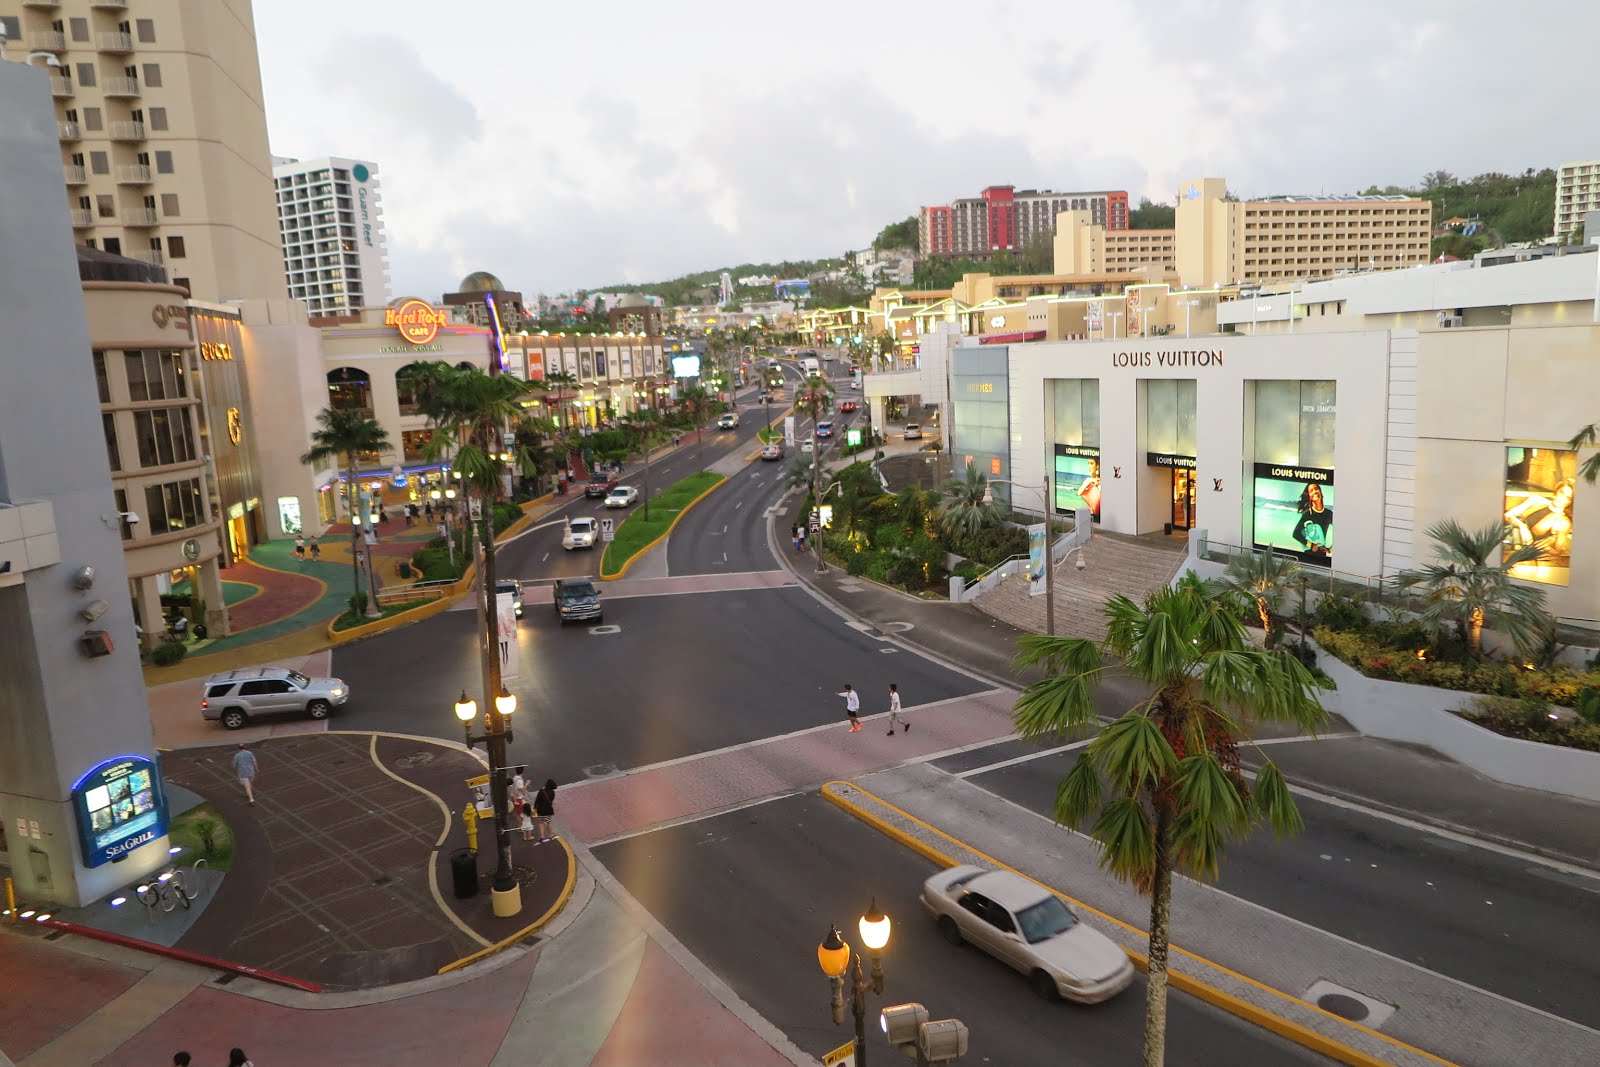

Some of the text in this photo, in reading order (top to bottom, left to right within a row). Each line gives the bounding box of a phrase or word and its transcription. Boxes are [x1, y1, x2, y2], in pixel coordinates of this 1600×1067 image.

[358, 187, 374, 248] Guam Reef
[385, 308, 447, 327] Hard Rock
[409, 328, 429, 336] CAFE
[200, 341, 233, 361] GUCCI
[1112, 350, 1224, 367] LOUIS VUITTON
[1065, 447, 1100, 457] LOUIS VUITTON
[1156, 456, 1173, 465] LOUIS
[1271, 467, 1327, 481] LOUIS VUITTON
